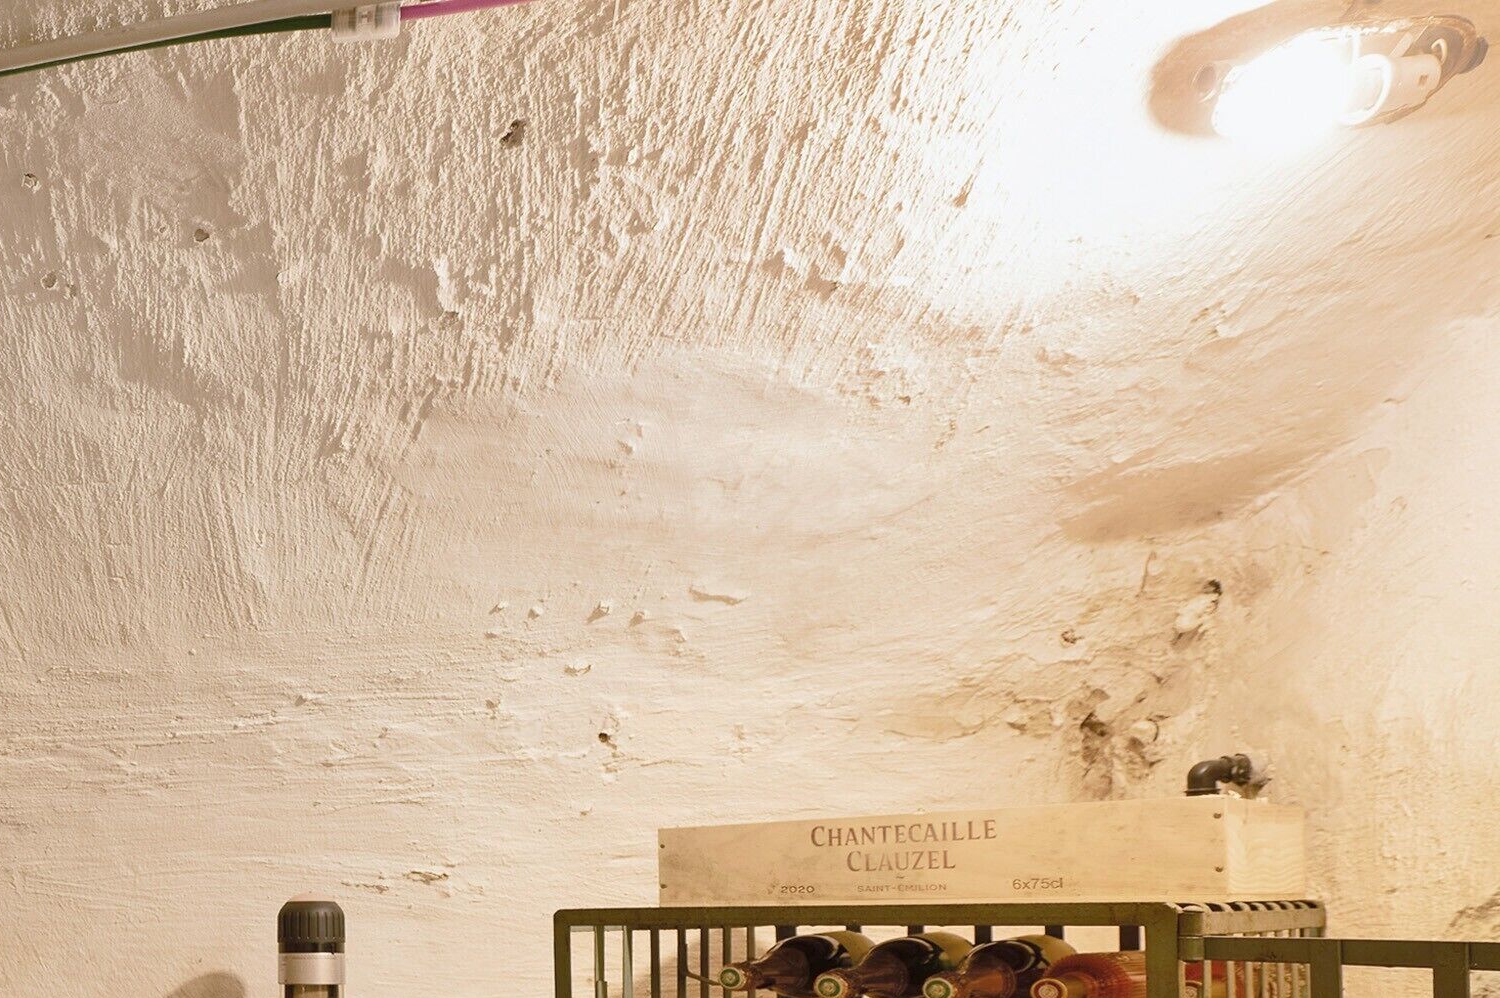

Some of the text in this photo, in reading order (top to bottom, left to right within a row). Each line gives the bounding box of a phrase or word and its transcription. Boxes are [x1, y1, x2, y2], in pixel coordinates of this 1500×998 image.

[810, 819, 997, 848] CHANTECAILLE
[846, 850, 956, 873] CLAUZEL
[780, 885, 815, 894] 2020
[1012, 877, 1063, 890] 6x75cl
